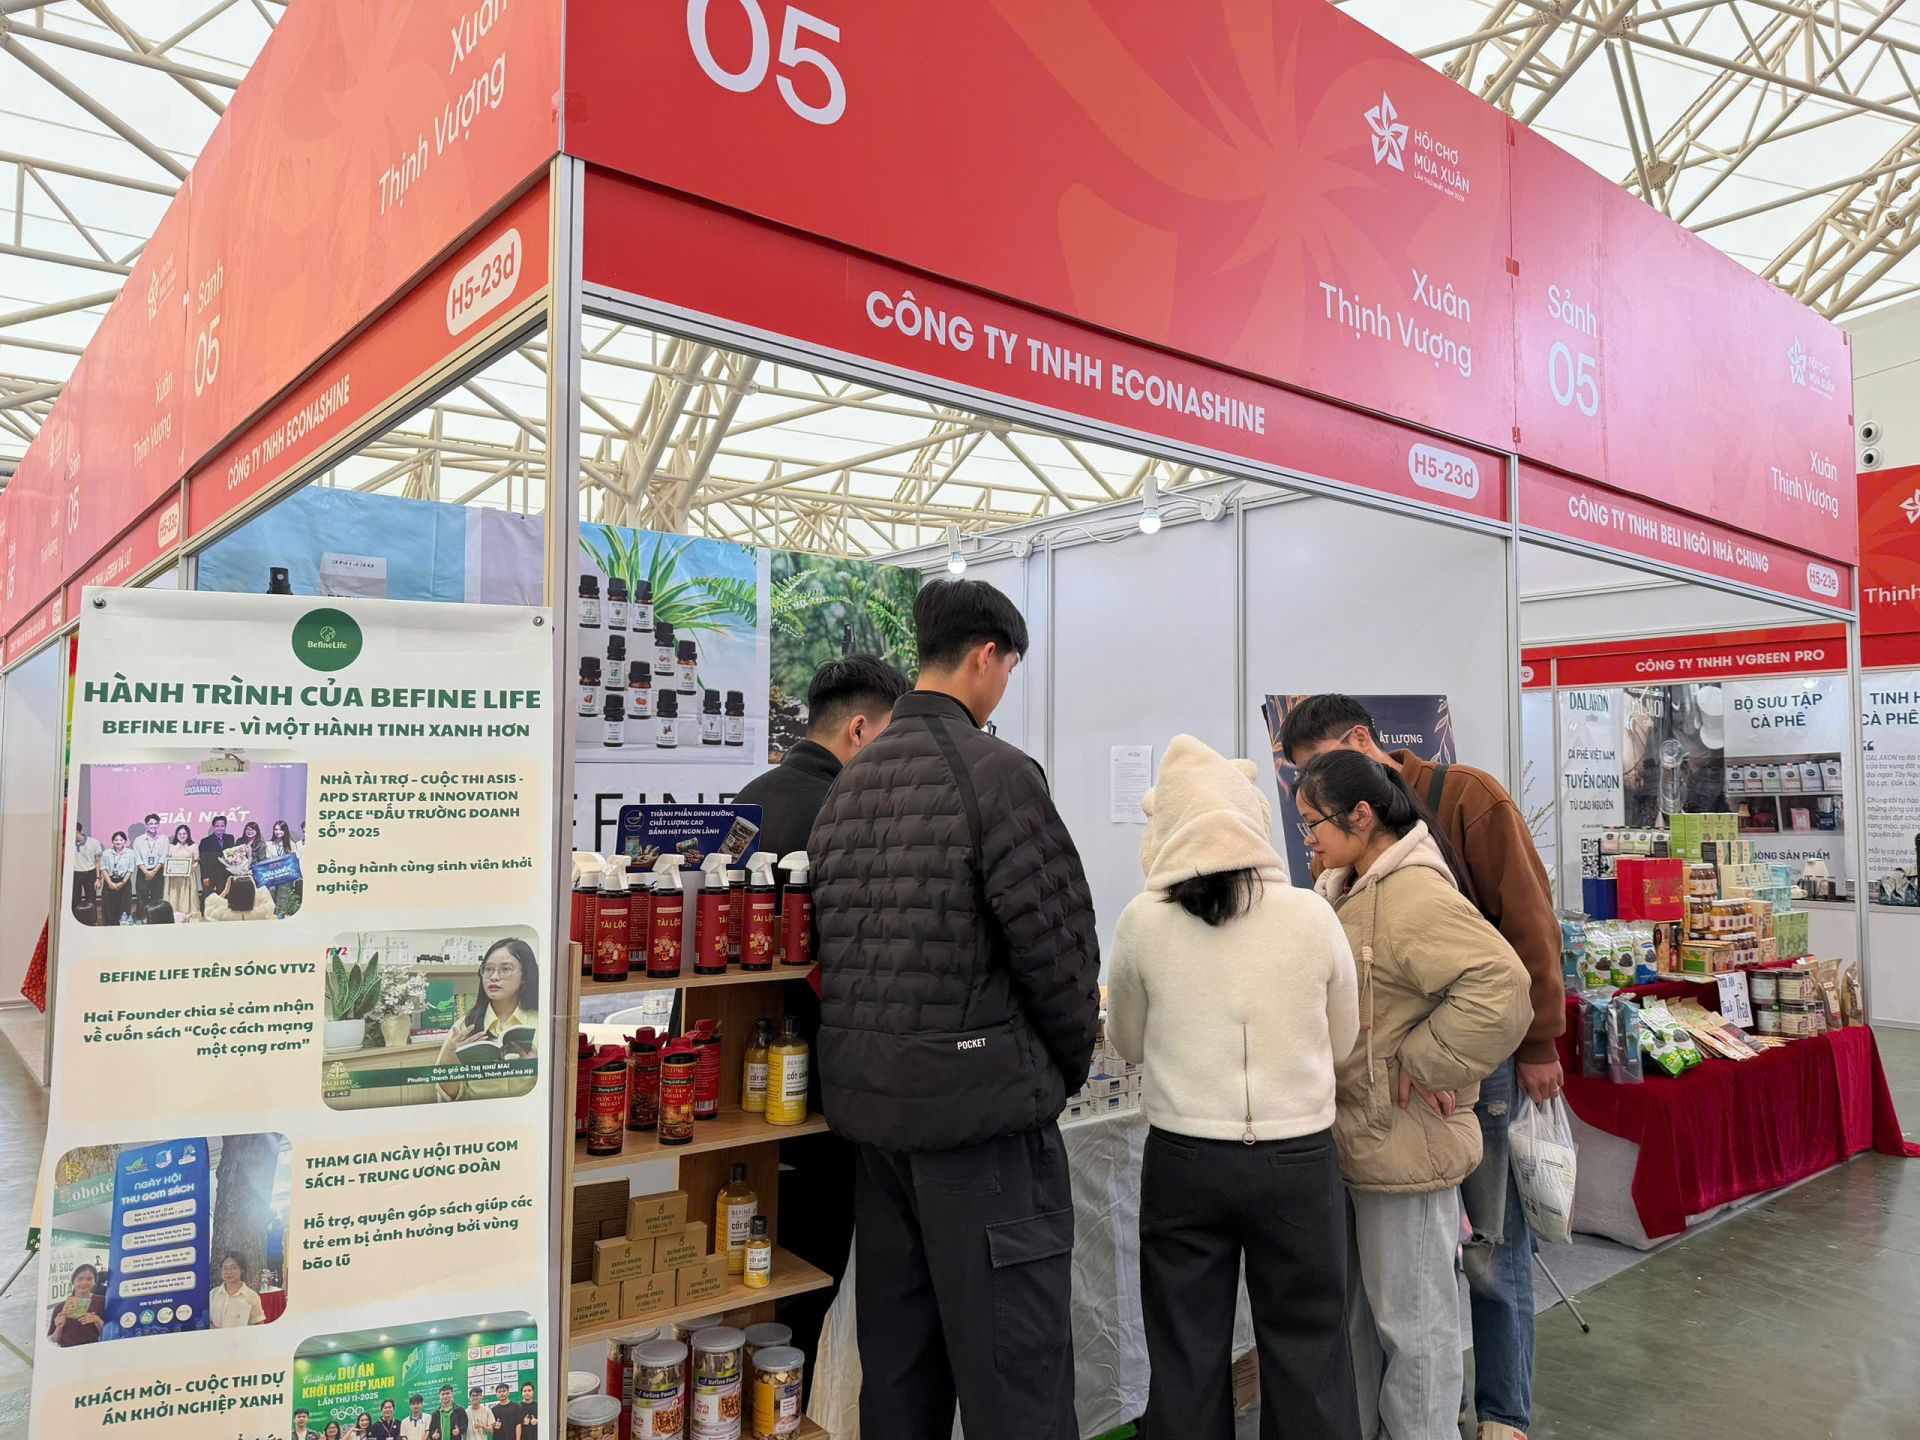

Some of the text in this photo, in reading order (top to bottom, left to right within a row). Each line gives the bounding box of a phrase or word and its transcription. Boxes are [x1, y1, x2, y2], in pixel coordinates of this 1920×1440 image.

[686, 0, 847, 125] 05
[379, 51, 506, 215] Thịnh Vượng
[1414, 129, 1458, 168] HỘI CHỢ
[1414, 152, 1470, 194] MÙA XUÂN
[451, 252, 516, 320] H5-23d
[1411, 268, 1471, 323] Xuân
[1548, 284, 1598, 338] Sảnh
[1319, 281, 1472, 378] Thịnh Vượng
[195, 313, 220, 397] 05
[866, 290, 1266, 435] CÔNG TY TNHH ECONASHINE
[1548, 341, 1599, 418] 05
[227, 374, 350, 491] CÔNG TY TNHH ECONASHINE
[1414, 452, 1475, 490] H5-23d
[1810, 450, 1838, 482] Xuân
[1770, 467, 1839, 519] Thịnh Vượng
[1568, 493, 1768, 574] CÔNG TY TNHH BELI NGÔI NHÀ CHUNG
[1809, 568, 1837, 592] H5-23e
[1863, 584, 1920, 606] Thịnh
[307, 639, 347, 650] BefineLife
[1636, 650, 1826, 673] CÔNG TY TNHH VGREEN PRO
[84, 671, 540, 709] HÀNH TRÌNH CỦA BEFINE LIFE
[1869, 691, 1908, 705] TINH
[1734, 692, 1822, 713] BỘ SƯU TẬP
[102, 716, 530, 740] BEFINE LIFE VÌ MỘT HÀNH TINH XANH HƠN
[1751, 712, 1806, 729] CÀ PHÊ
[1886, 709, 1918, 725] PHÊ
[1392, 733, 1423, 746] LƯỢNG
[320, 771, 516, 788] NHÀ TÀI TRỢ CUỘC THI ASIS
[1564, 768, 1620, 792] TUYỂN CHỌN
[320, 790, 518, 802] APD STARTUP INNOVATION
[318, 810, 364, 820] SPACE
[408, 805, 466, 819] TRƯỜNG
[469, 808, 520, 818] DOANH
[650, 809, 674, 817] THÀNH
[318, 820, 380, 838] SỐ” 2025
[316, 856, 533, 876] Đồng hành cùng sinh viên khởi
[1780, 849, 1800, 860] SẢN
[1802, 848, 1830, 861] PHẨM
[316, 880, 369, 894] nghiệp
[600, 920, 627, 929] TÀI LỘC
[656, 918, 681, 927] TÀI LỘC
[753, 914, 774, 922] TÀI LỘC
[100, 960, 316, 984] BEFINE LIFE TRÊN SÓNG VTV2
[957, 1038, 986, 1050] POCKET
[306, 1140, 518, 1170] THAM GIA NGÀY HỘI THU GOM
[305, 1157, 501, 1189] SÁCH TRUNG ƯƠNG ĐOÀN
[74, 1370, 286, 1408] KHÁCH MỜI CUỘC THI DỰ
[102, 1392, 284, 1426] ÁN KHỞI NGHIỆP XANH
